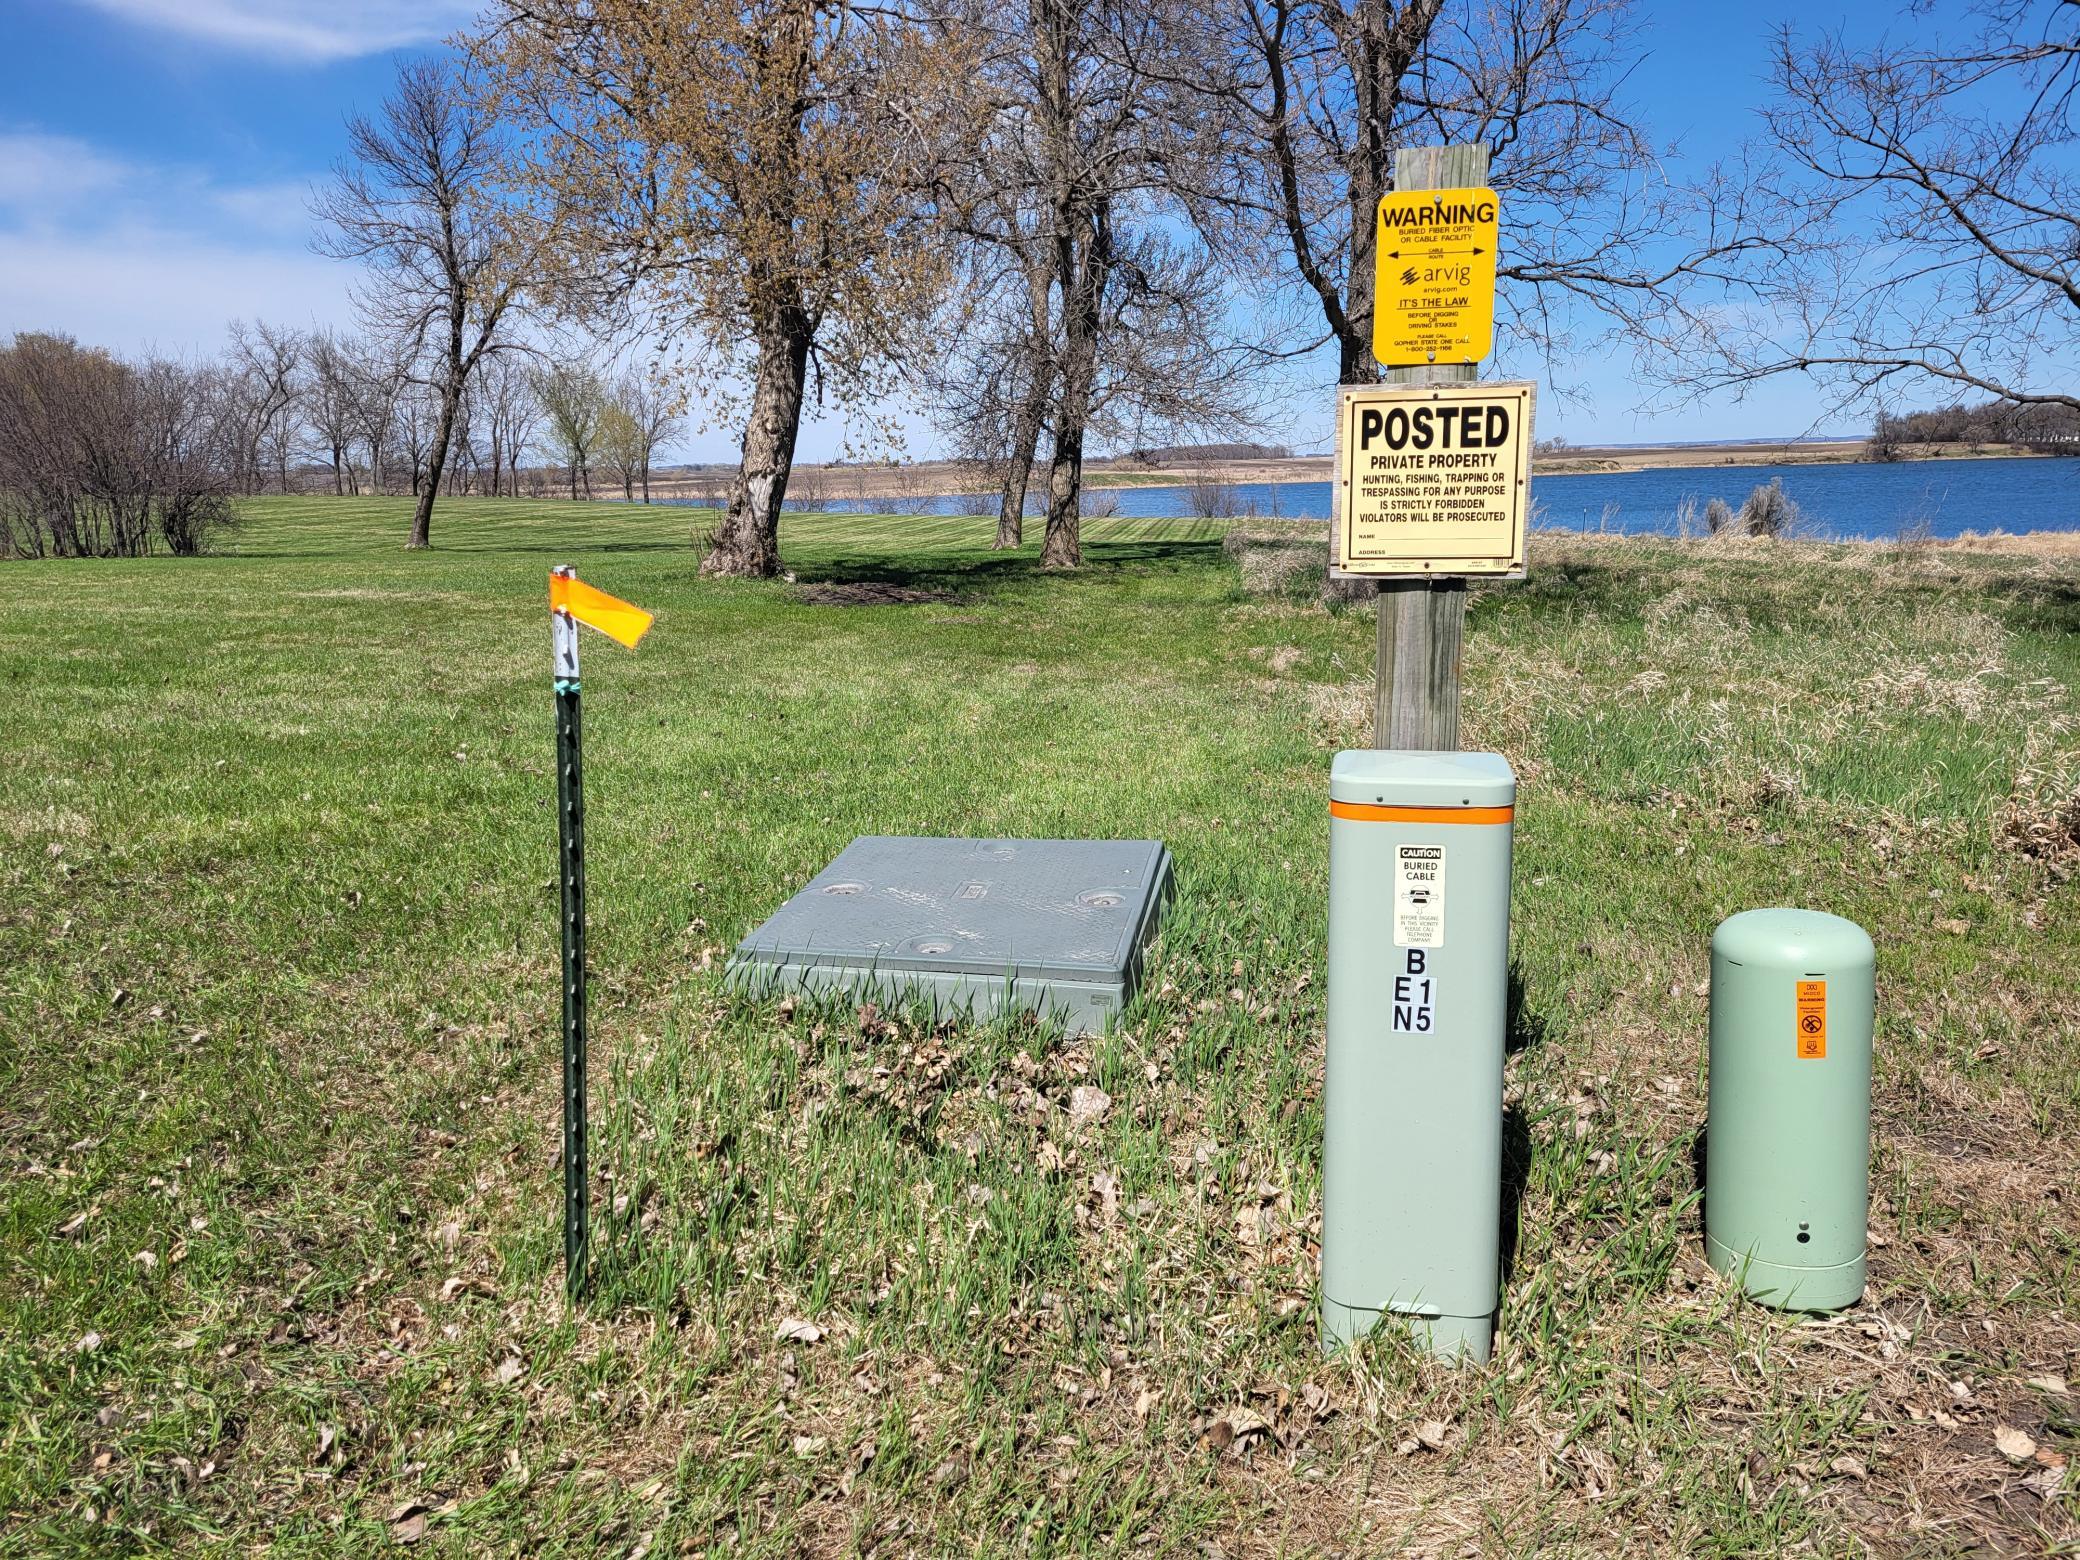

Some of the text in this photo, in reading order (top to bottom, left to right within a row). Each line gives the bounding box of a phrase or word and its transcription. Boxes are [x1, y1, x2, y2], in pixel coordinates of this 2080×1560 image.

[1382, 202, 1494, 228] WARNING
[1399, 225, 1475, 236] BURIED FIBER OPTIC
[1400, 233, 1472, 244] OR CABLE FACILITY
[1423, 262, 1471, 286] arvig
[1423, 286, 1458, 294] arvig.com
[1399, 296, 1469, 308] IT'S THE LAW
[1407, 311, 1431, 319] BEFORE
[1361, 405, 1510, 451] POSTED
[1370, 453, 1497, 470] PRIVATE PROPERTY
[1362, 472, 1505, 486] HUNTING, FISHING, TRAPPING OR
[1361, 485, 1506, 498] TRESPASSING FOR ANY PURPOSE
[1380, 499, 1485, 510] IS STRICTLY FORBIDDEN
[1359, 511, 1506, 523] VIOLATORS WILL BE PROSECUTED
[1401, 849, 1440, 858] CAUTION
[1404, 861, 1438, 871] BURIED
[1406, 872, 1435, 881] CABLE
[1406, 948, 1426, 975] B
